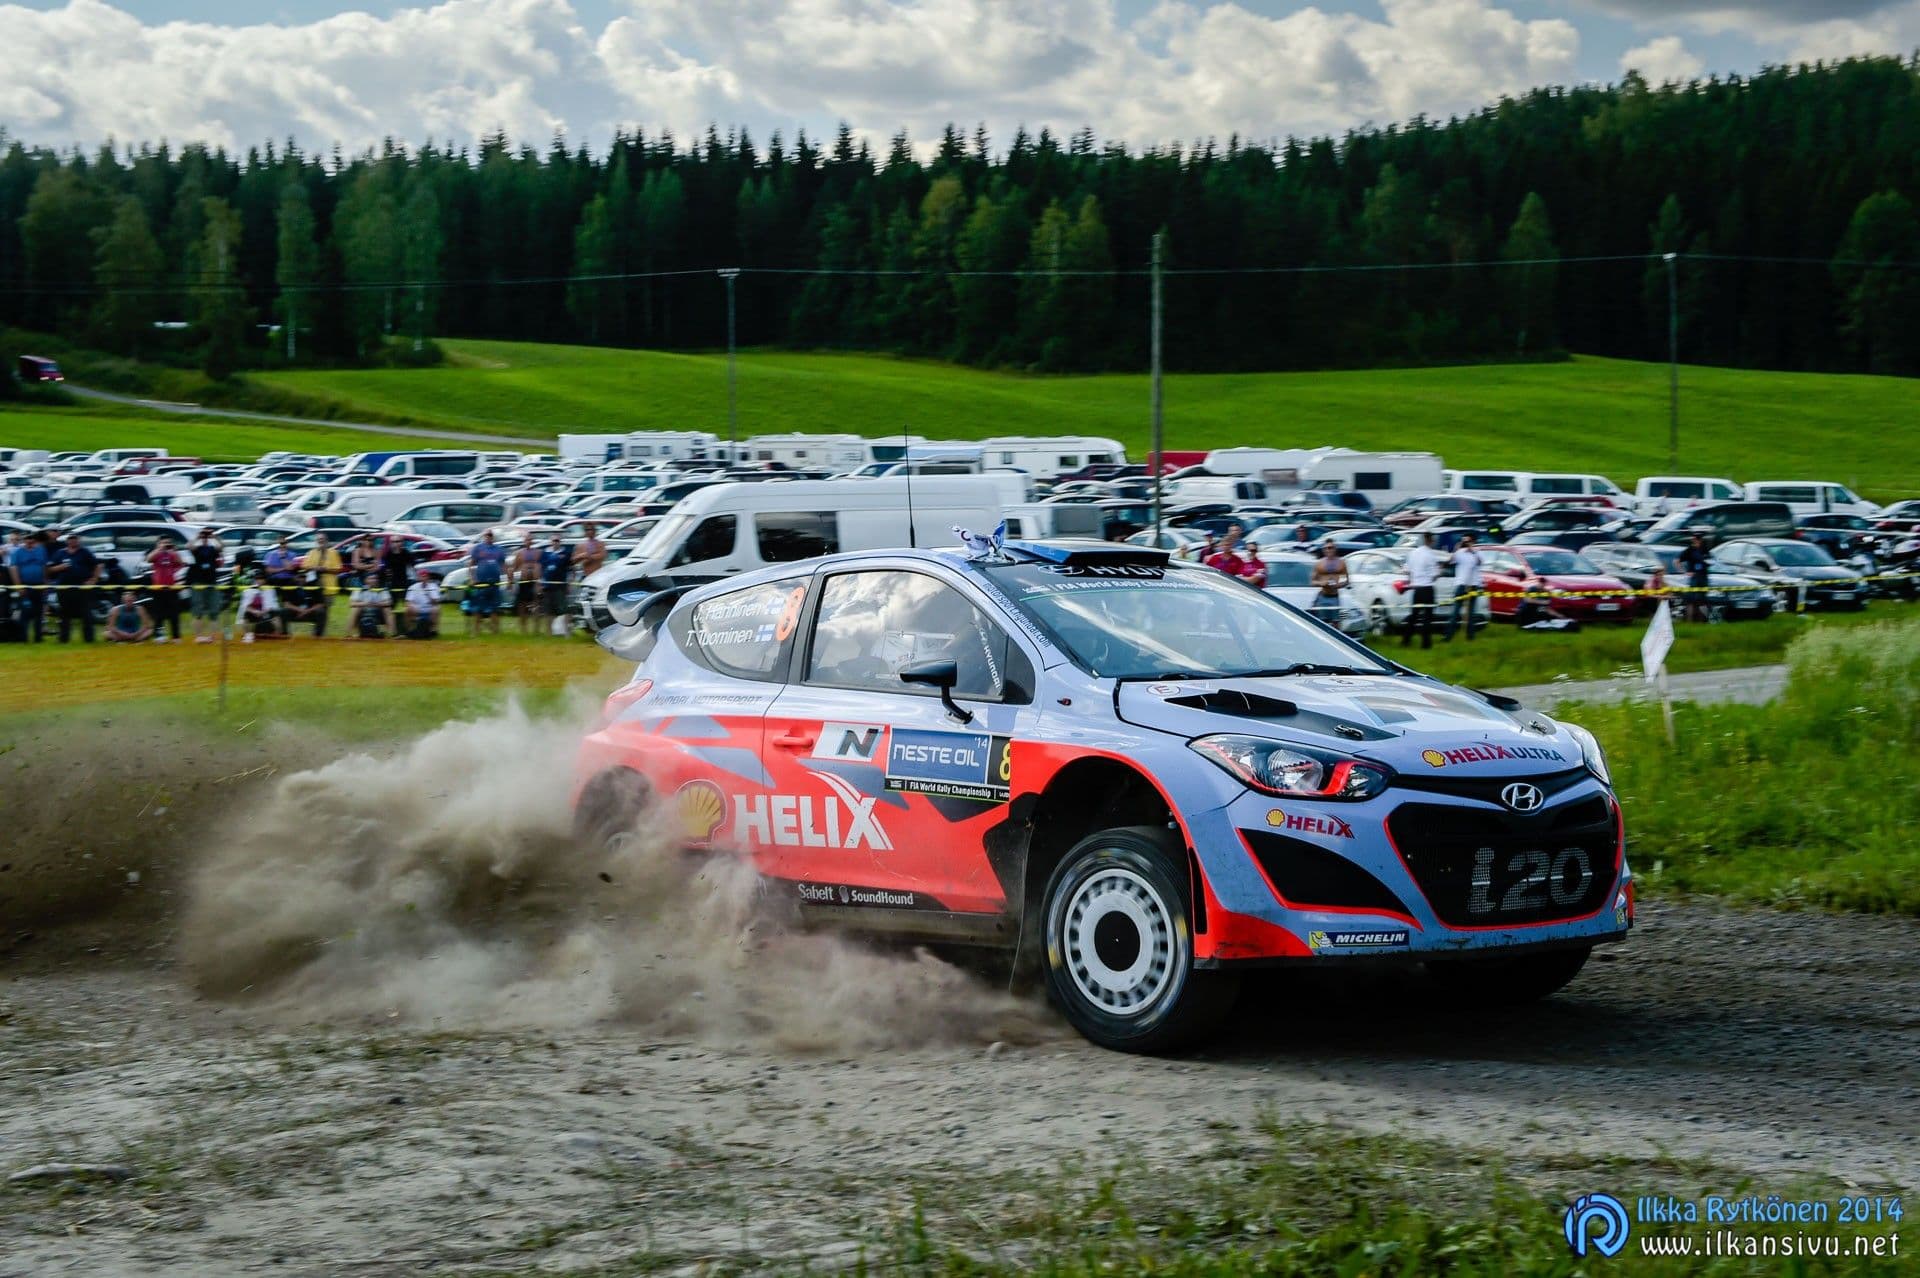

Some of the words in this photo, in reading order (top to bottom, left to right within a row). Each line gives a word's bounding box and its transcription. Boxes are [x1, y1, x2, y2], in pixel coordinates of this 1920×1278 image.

[685, 630, 697, 647] T.
[698, 628, 753, 646] Tuominen
[838, 728, 880, 757] N
[1443, 741, 1517, 765] HELIX
[1508, 747, 1567, 762] ULTRA
[893, 744, 953, 764] NESTE
[954, 748, 980, 768] OIL
[909, 781, 919, 790] FIA
[920, 783, 936, 792] World
[937, 785, 951, 794] Rally
[951, 786, 991, 798] Championship
[732, 771, 894, 850] HELIX
[1286, 813, 1355, 839] HELIX
[798, 883, 834, 901] Sabelt
[851, 890, 914, 905] SoundHound
[1335, 933, 1405, 943] MICHELIN
